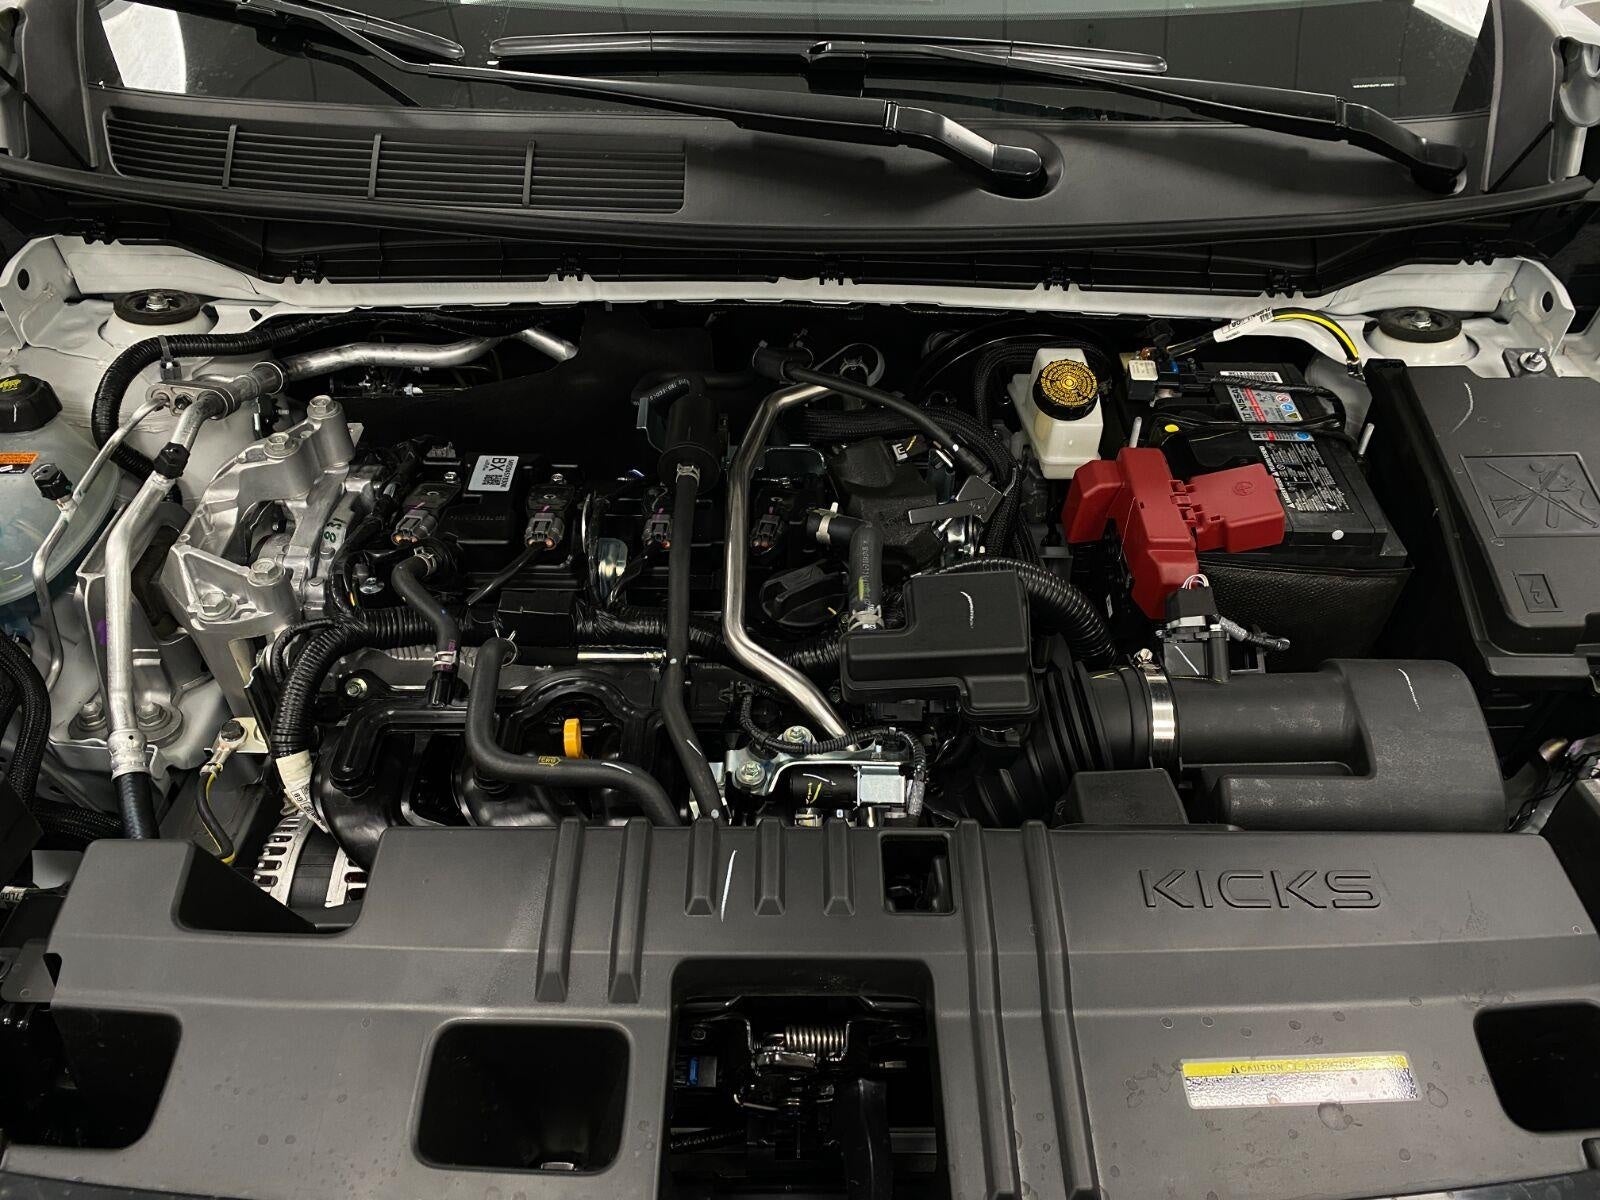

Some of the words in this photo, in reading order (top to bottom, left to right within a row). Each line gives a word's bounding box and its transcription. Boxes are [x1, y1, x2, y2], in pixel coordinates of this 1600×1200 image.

[489, 457, 507, 471] BX
[1138, 869, 1382, 909] KICKS
[1239, 1063, 1284, 1073] CAUTION
